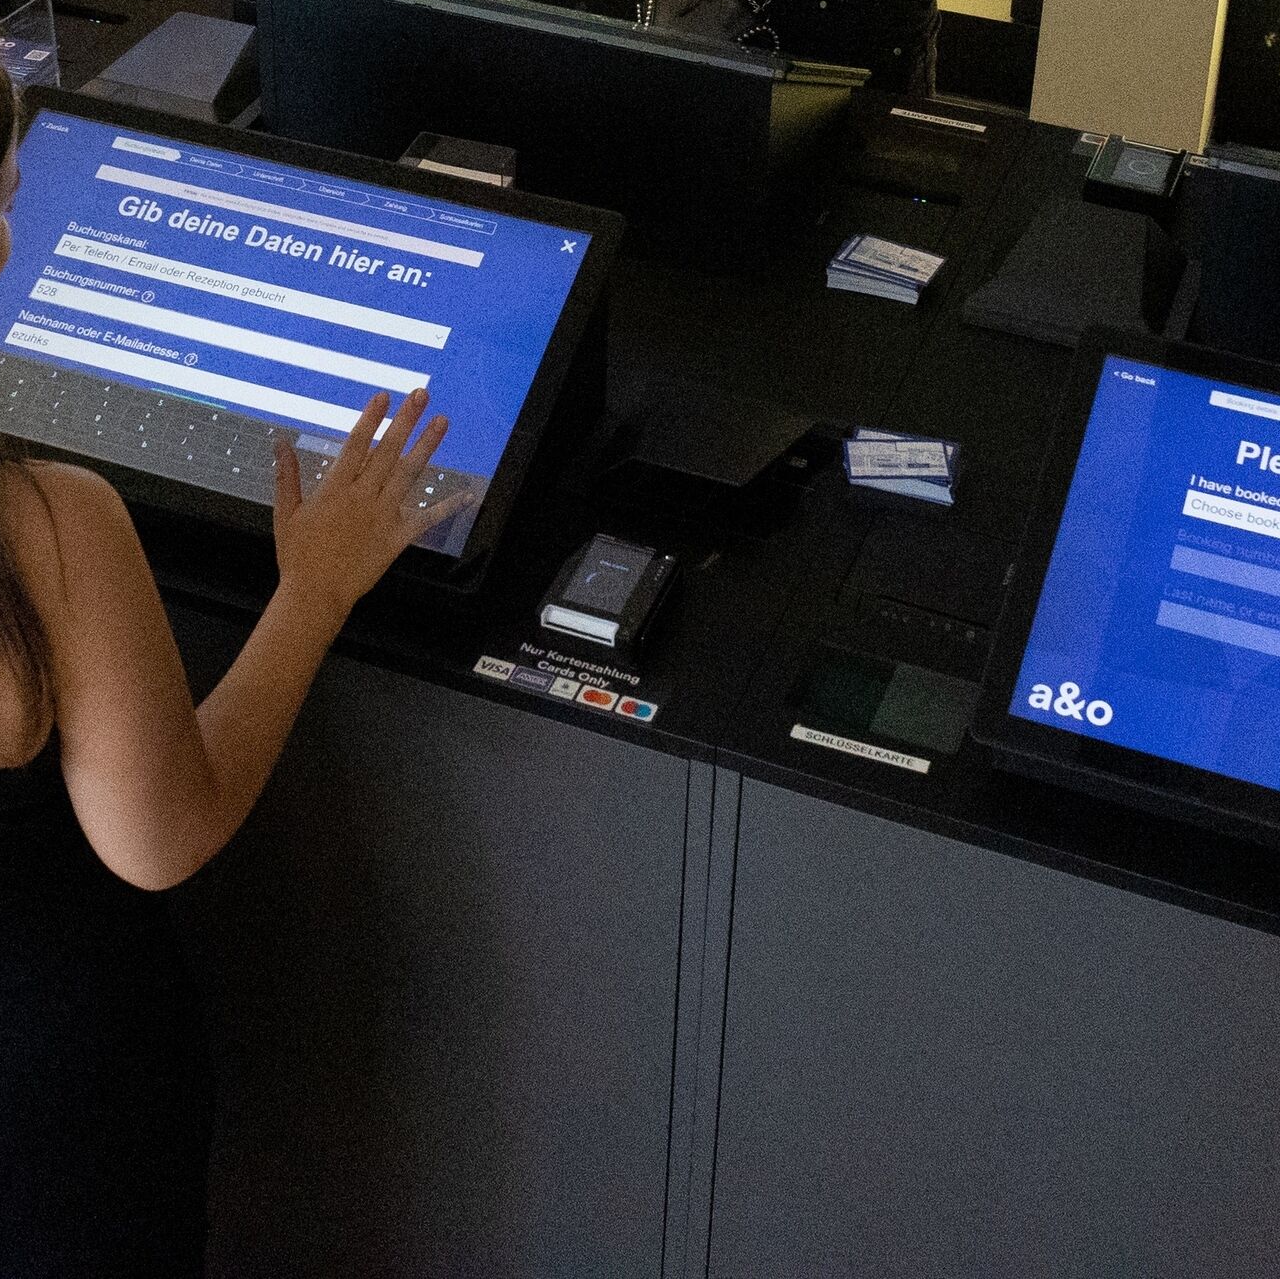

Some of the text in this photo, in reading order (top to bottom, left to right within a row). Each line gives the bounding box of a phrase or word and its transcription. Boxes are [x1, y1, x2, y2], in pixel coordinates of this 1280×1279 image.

[67, 221, 149, 250] Buchungskanal:
[119, 196, 163, 223] Gib
[168, 209, 239, 241] deine
[245, 225, 323, 262] Daten
[328, 244, 385, 275] hier
[387, 262, 432, 288] an:
[42, 265, 140, 298] Buchungsnummer:
[61, 240, 82, 254] Per
[83, 245, 120, 264] Telefon
[127, 257, 160, 272] Email
[160, 265, 184, 278] oder
[186, 270, 239, 292] Rezeption
[241, 285, 287, 304] gebucht
[36, 284, 58, 297] 528
[18, 309, 184, 361] Nachname oder E-Mailadresse:
[1120, 372, 1156, 386] Go back
[1198, 476, 1232, 495] have
[1190, 498, 1243, 521] Choose
[480, 660, 510, 677] VISA
[520, 642, 545, 656] Nur
[546, 649, 641, 685] Kartenzahlung
[537, 661, 611, 689] Cards Only
[1028, 681, 1114, 727] a&o
